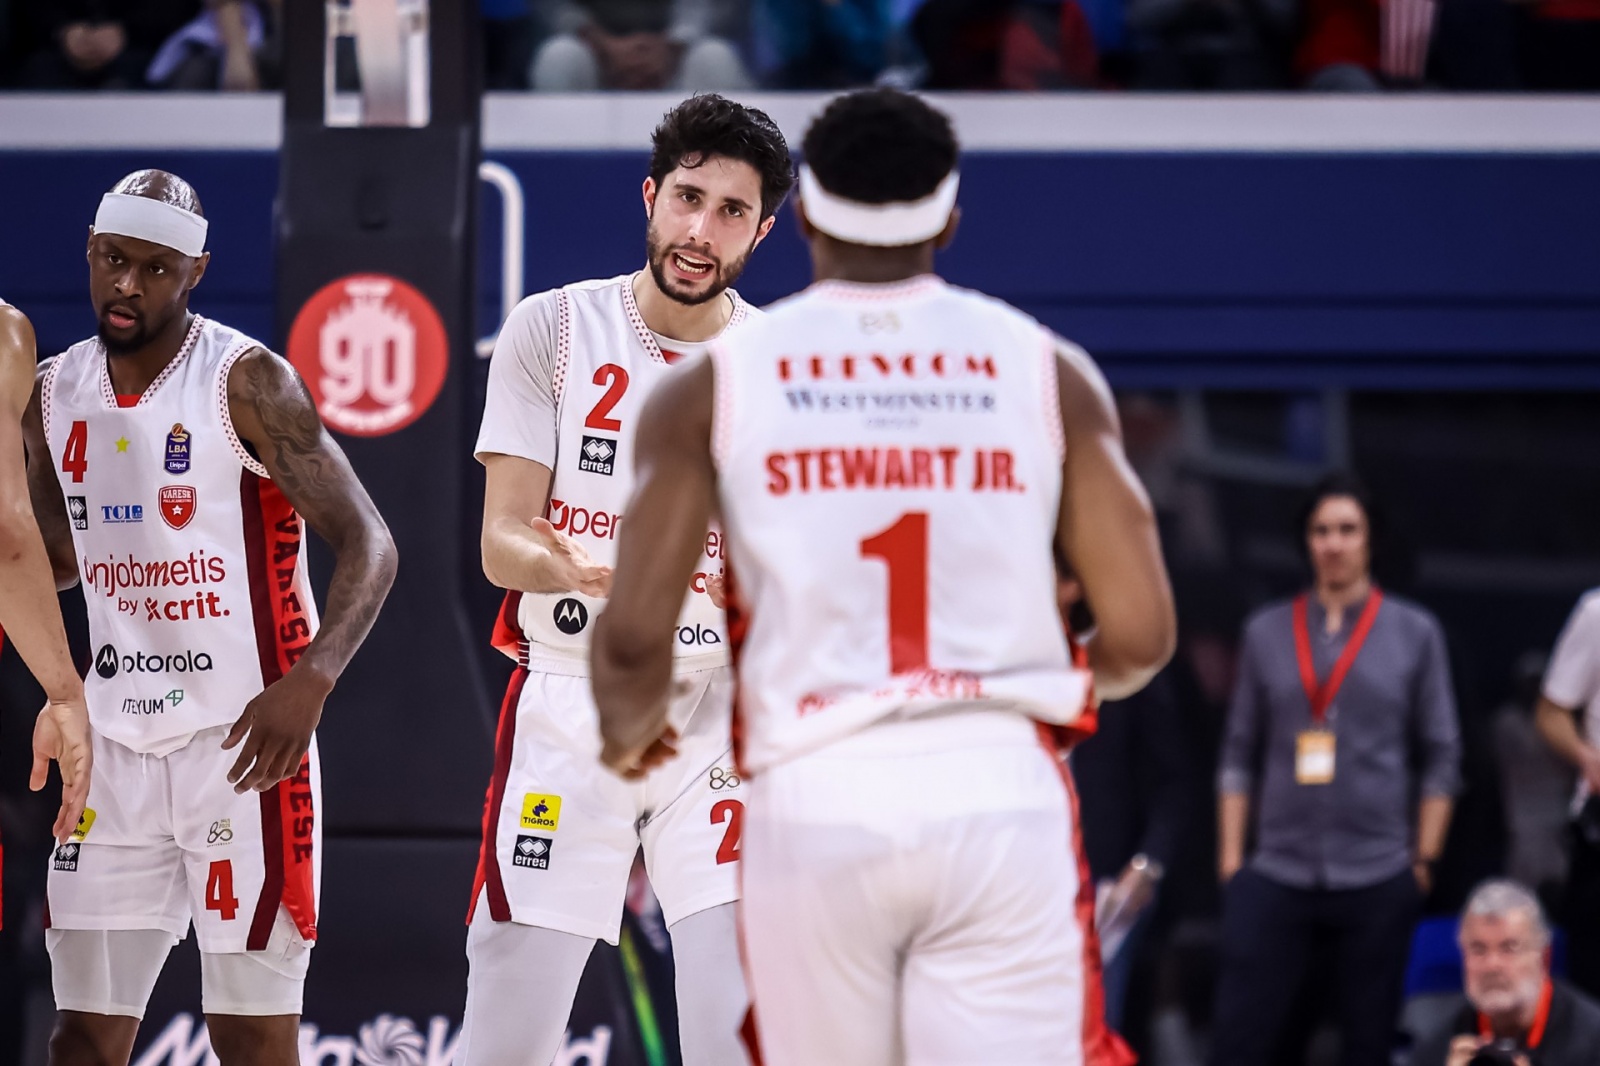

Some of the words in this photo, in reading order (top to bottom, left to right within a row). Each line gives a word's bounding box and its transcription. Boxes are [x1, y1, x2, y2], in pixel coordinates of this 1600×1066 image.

[585, 363, 629, 432] 2
[62, 421, 88, 483] 4
[168, 445, 187, 454] LBA
[580, 459, 612, 474] errea
[765, 447, 960, 496] STEWART
[970, 449, 1027, 493] JR.
[162, 490, 192, 499] VARESE
[118, 597, 138, 616] by
[859, 510, 931, 676] 1
[523, 816, 555, 827] TIGROS
[710, 799, 747, 865] 2
[514, 854, 547, 869] errea
[205, 859, 239, 920] 4
